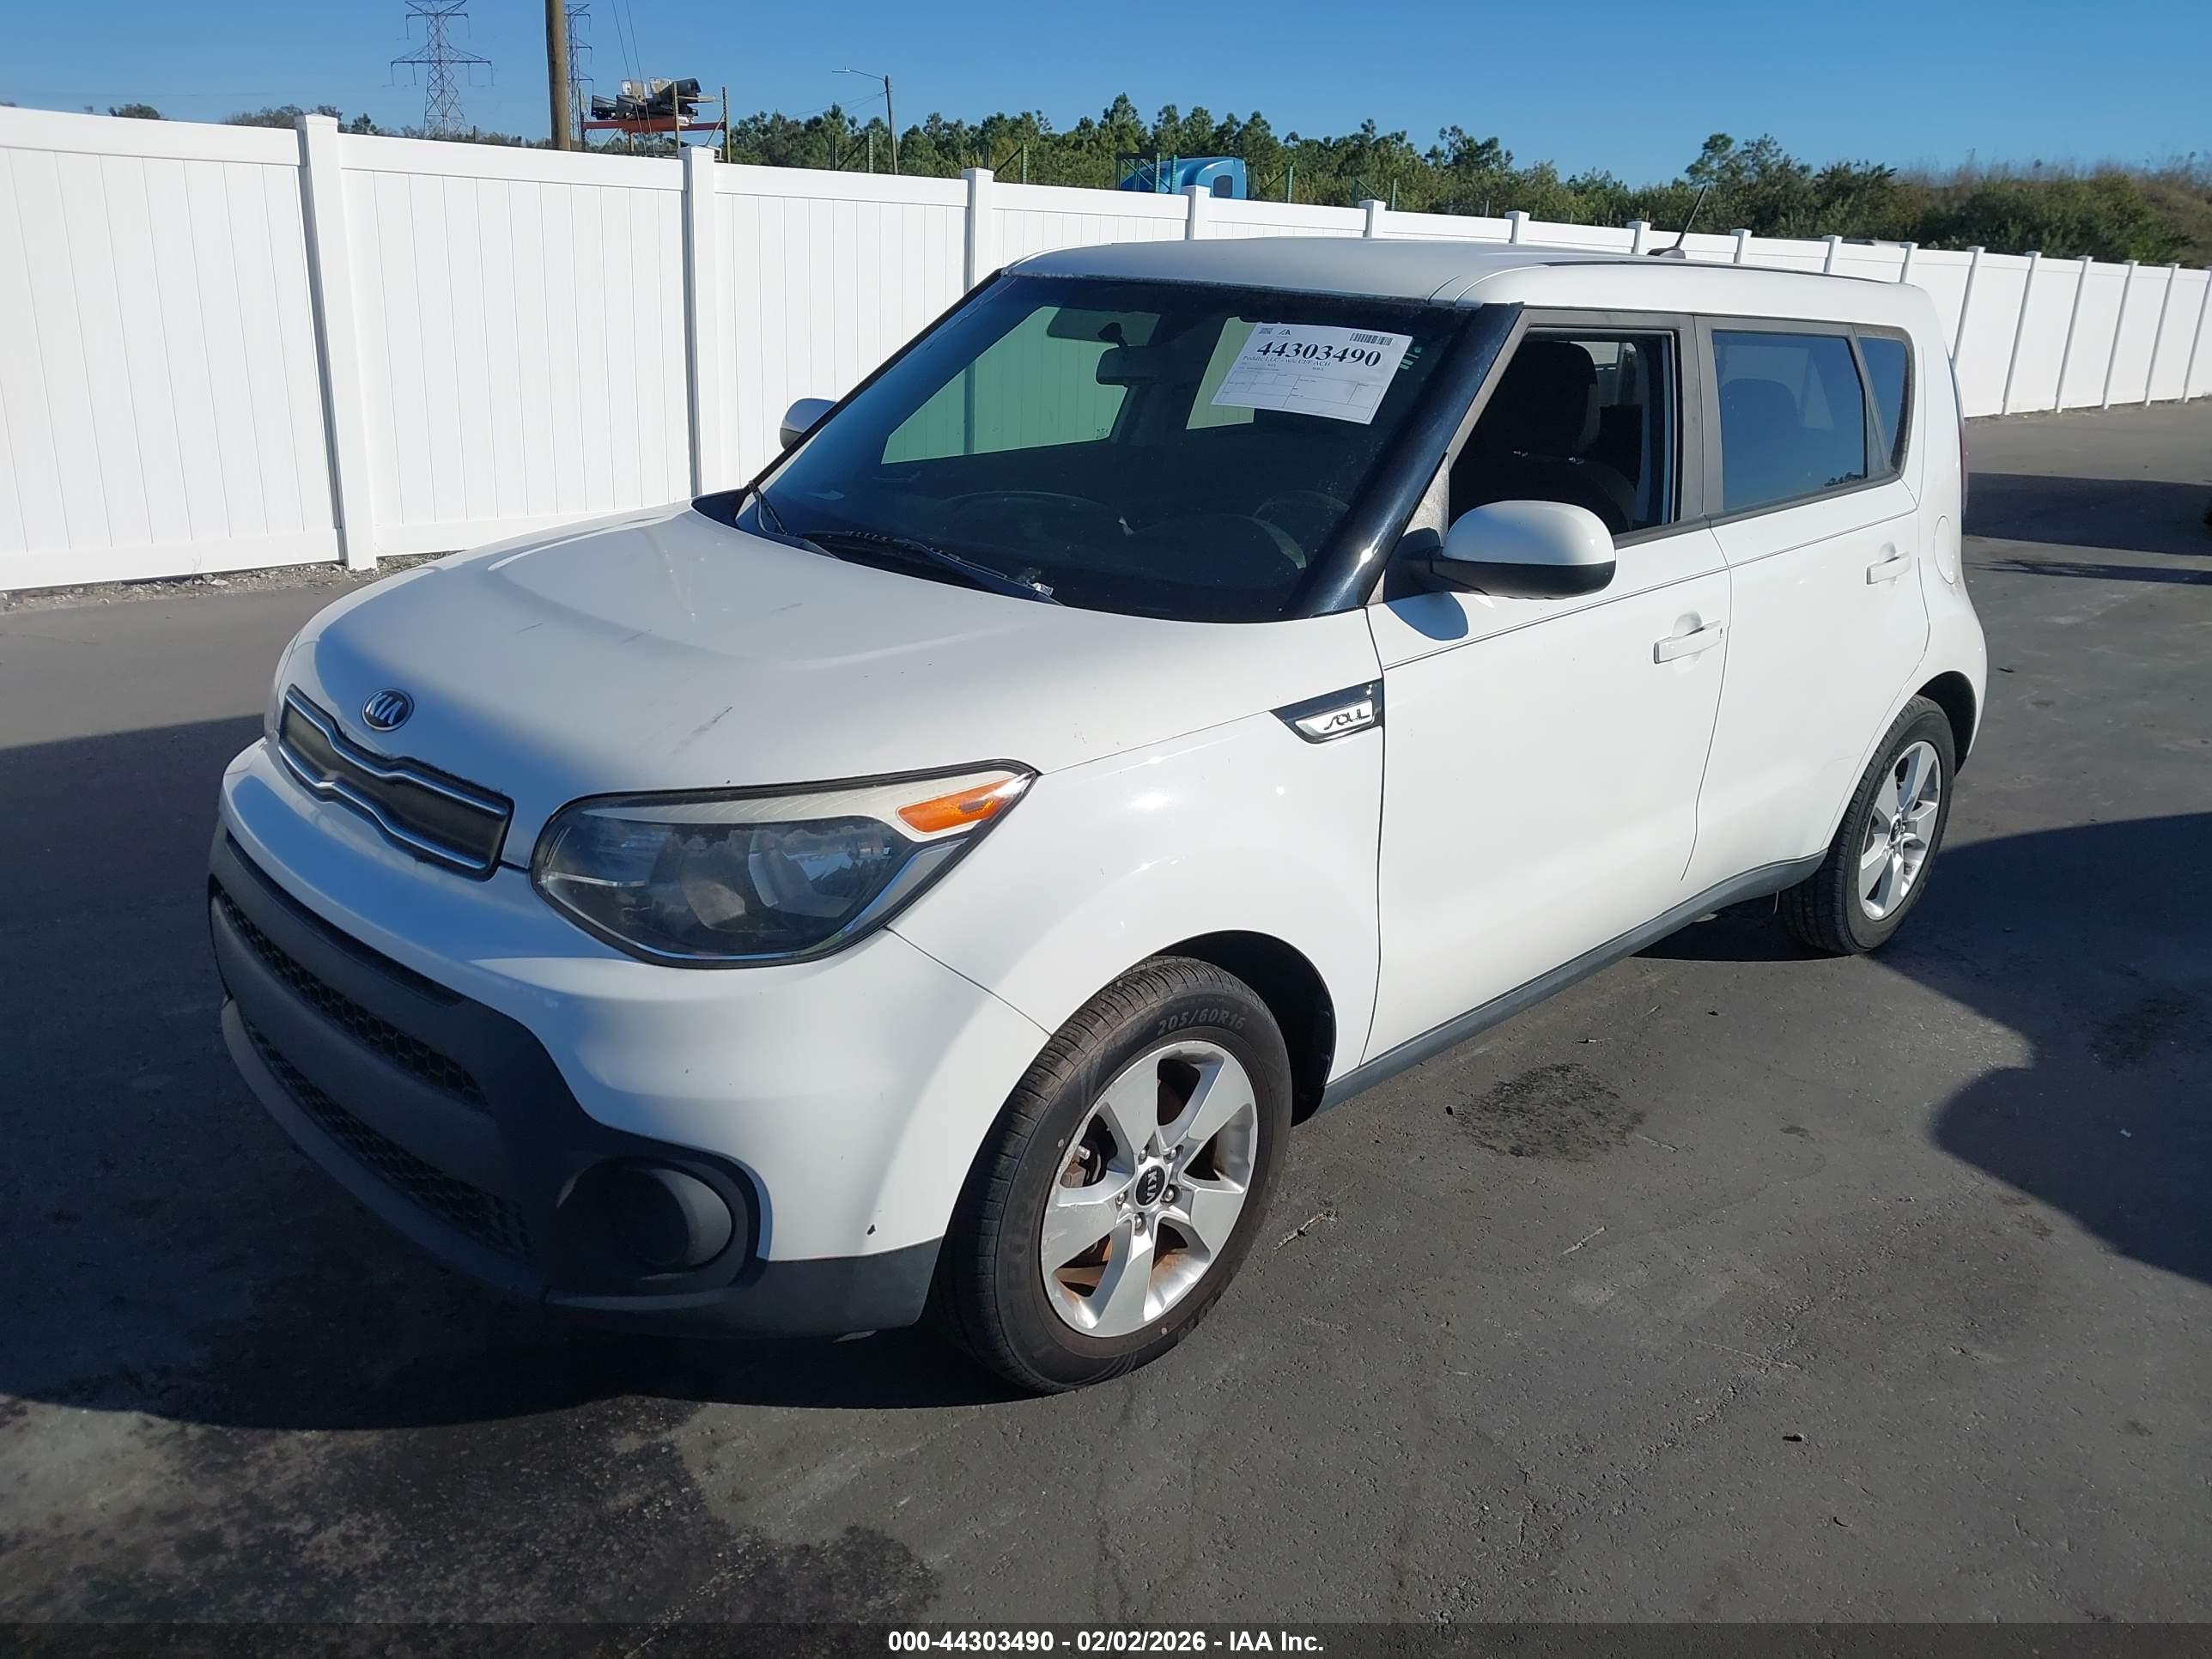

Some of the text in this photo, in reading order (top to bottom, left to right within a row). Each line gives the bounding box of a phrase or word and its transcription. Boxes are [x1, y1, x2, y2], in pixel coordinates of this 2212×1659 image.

[1256, 341, 1382, 368] 44303490
[366, 692, 403, 725] KIA
[1323, 708, 1370, 731] SOUL
[1157, 1008, 1247, 1036] 205/60R16
[1146, 1170, 1158, 1203] KIA
